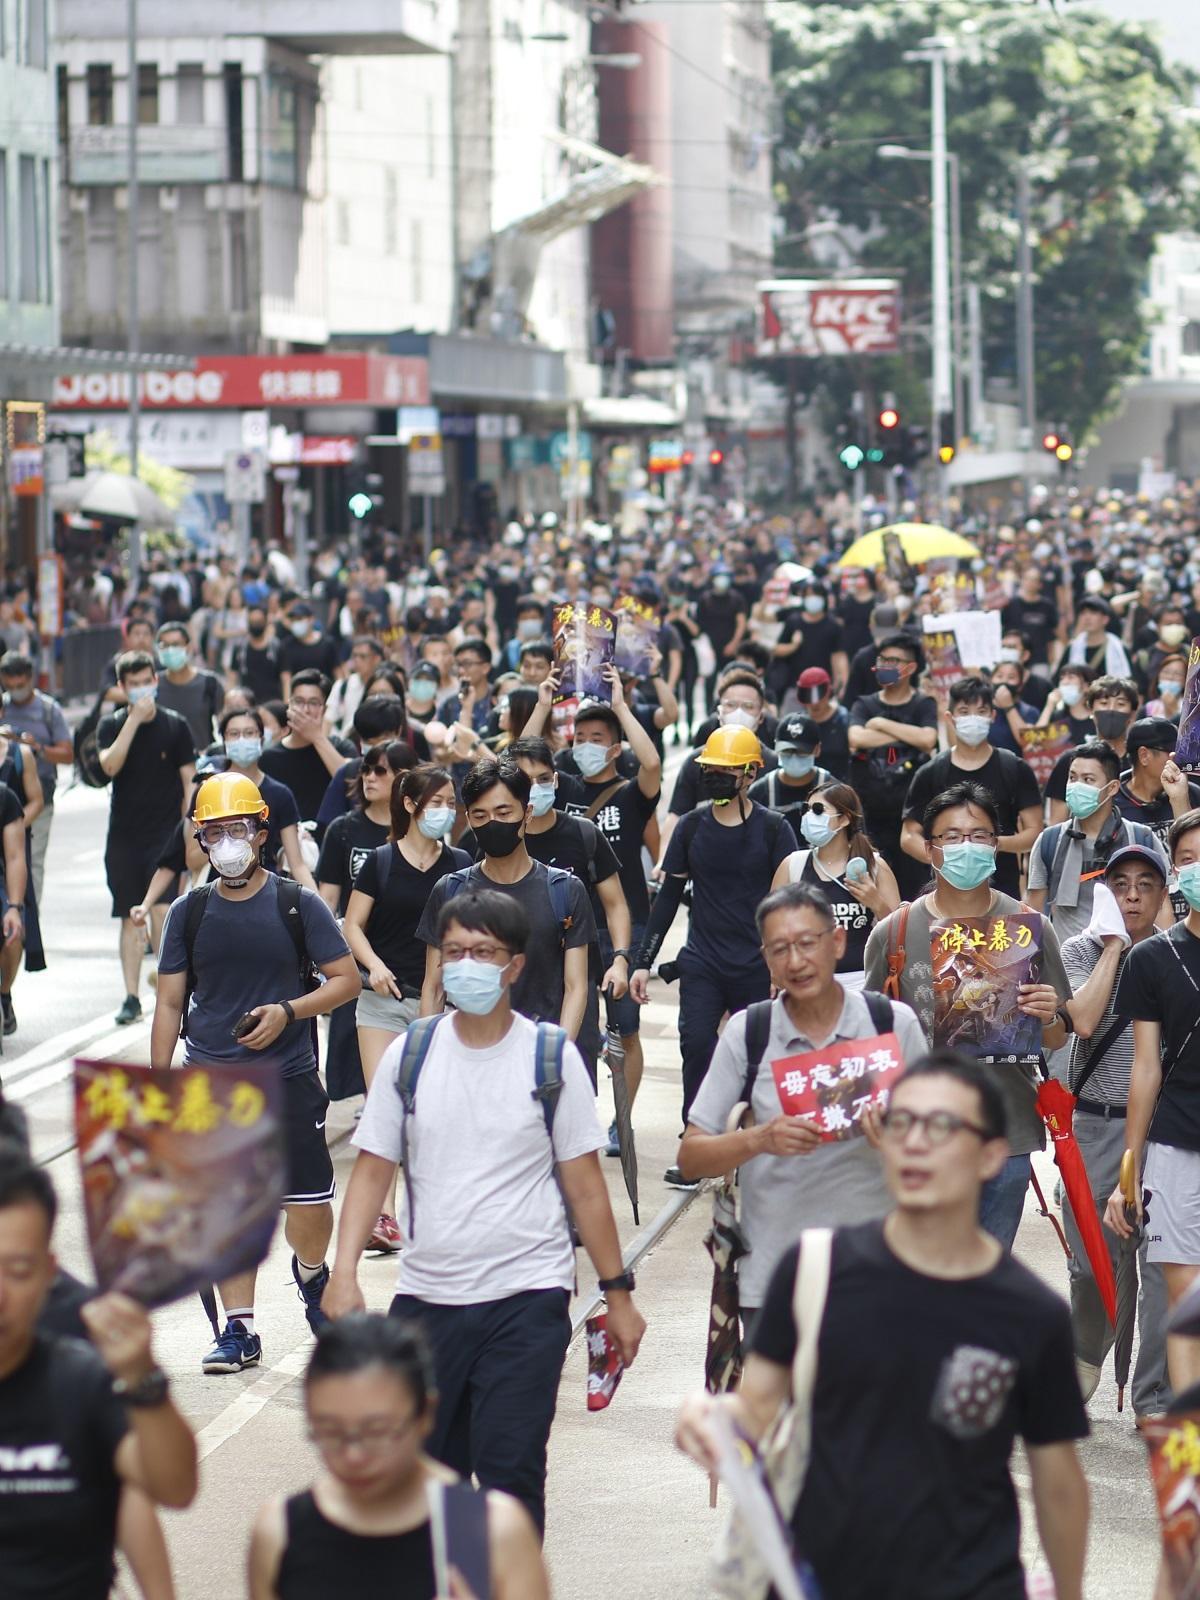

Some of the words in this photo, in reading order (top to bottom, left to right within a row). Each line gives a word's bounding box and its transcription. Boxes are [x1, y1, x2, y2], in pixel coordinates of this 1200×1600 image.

[814, 296, 895, 325] KFC
[940, 920, 1032, 953] 停止暴力
